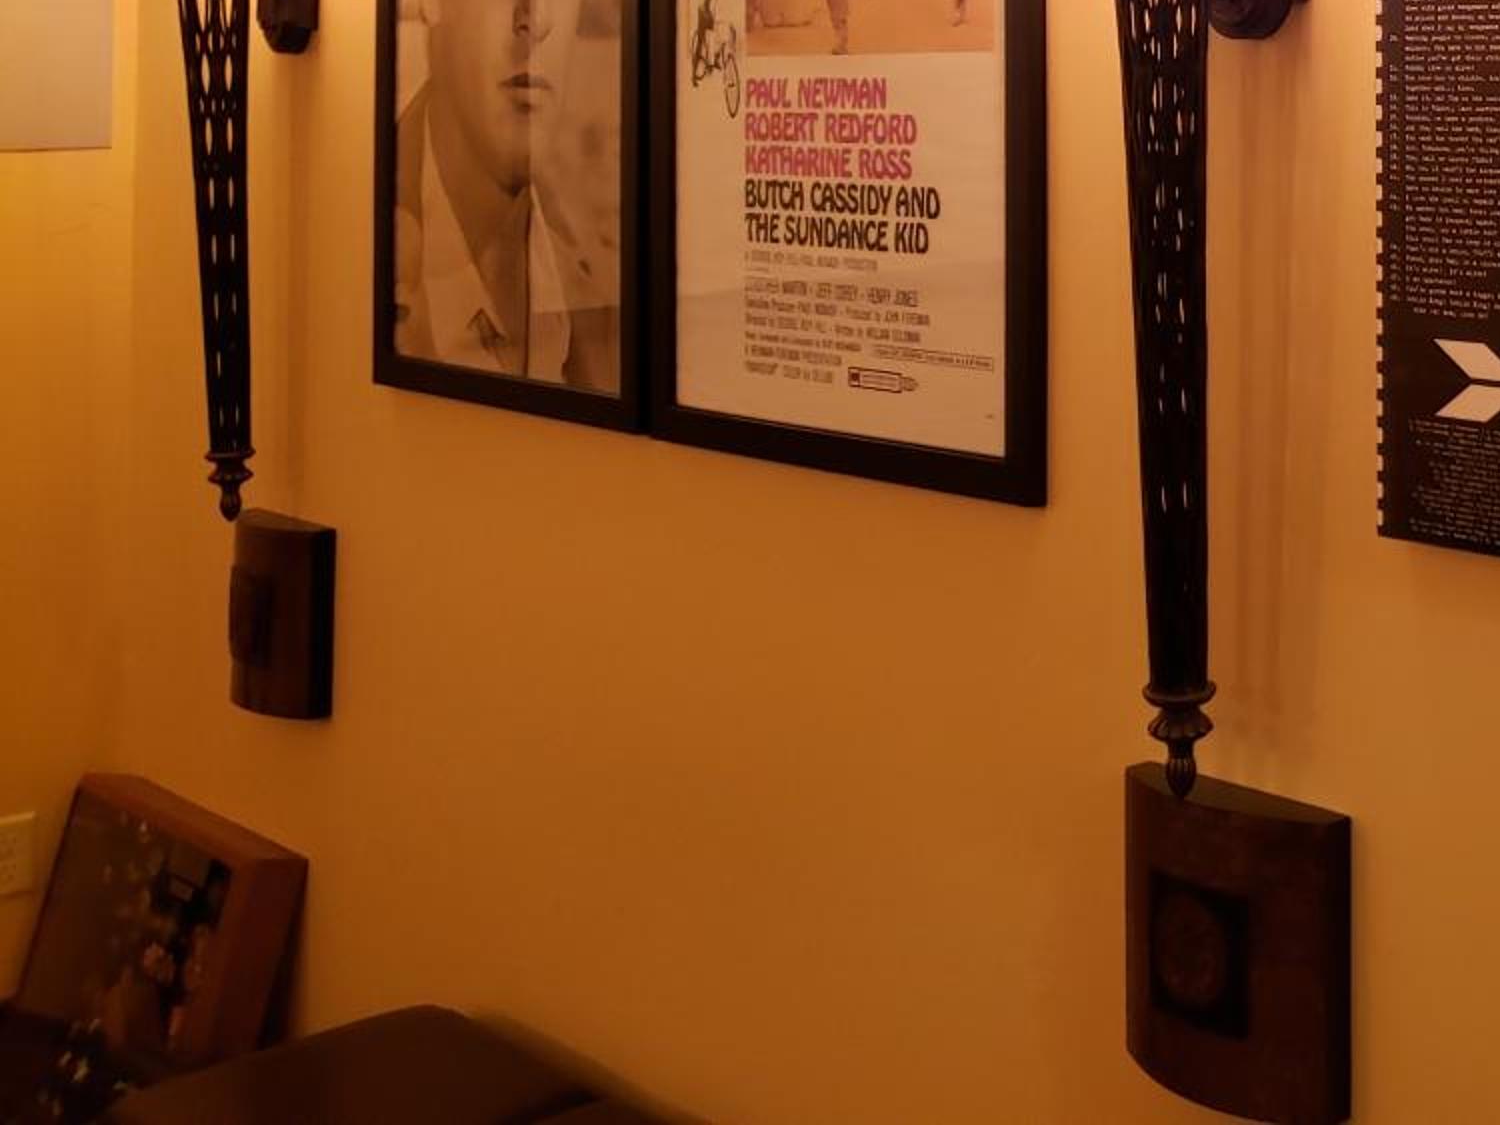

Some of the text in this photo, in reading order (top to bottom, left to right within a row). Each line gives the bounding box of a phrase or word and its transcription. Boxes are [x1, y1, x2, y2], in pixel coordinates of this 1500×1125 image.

[746, 77, 886, 109] PAUL NEWMAN
[745, 112, 917, 144] ROBERT REDFORD
[745, 145, 913, 179] KATHARINE ROSS
[744, 179, 940, 219] BUTCH CASSIDY AND
[744, 213, 929, 254] THE SUNDANCE KID
